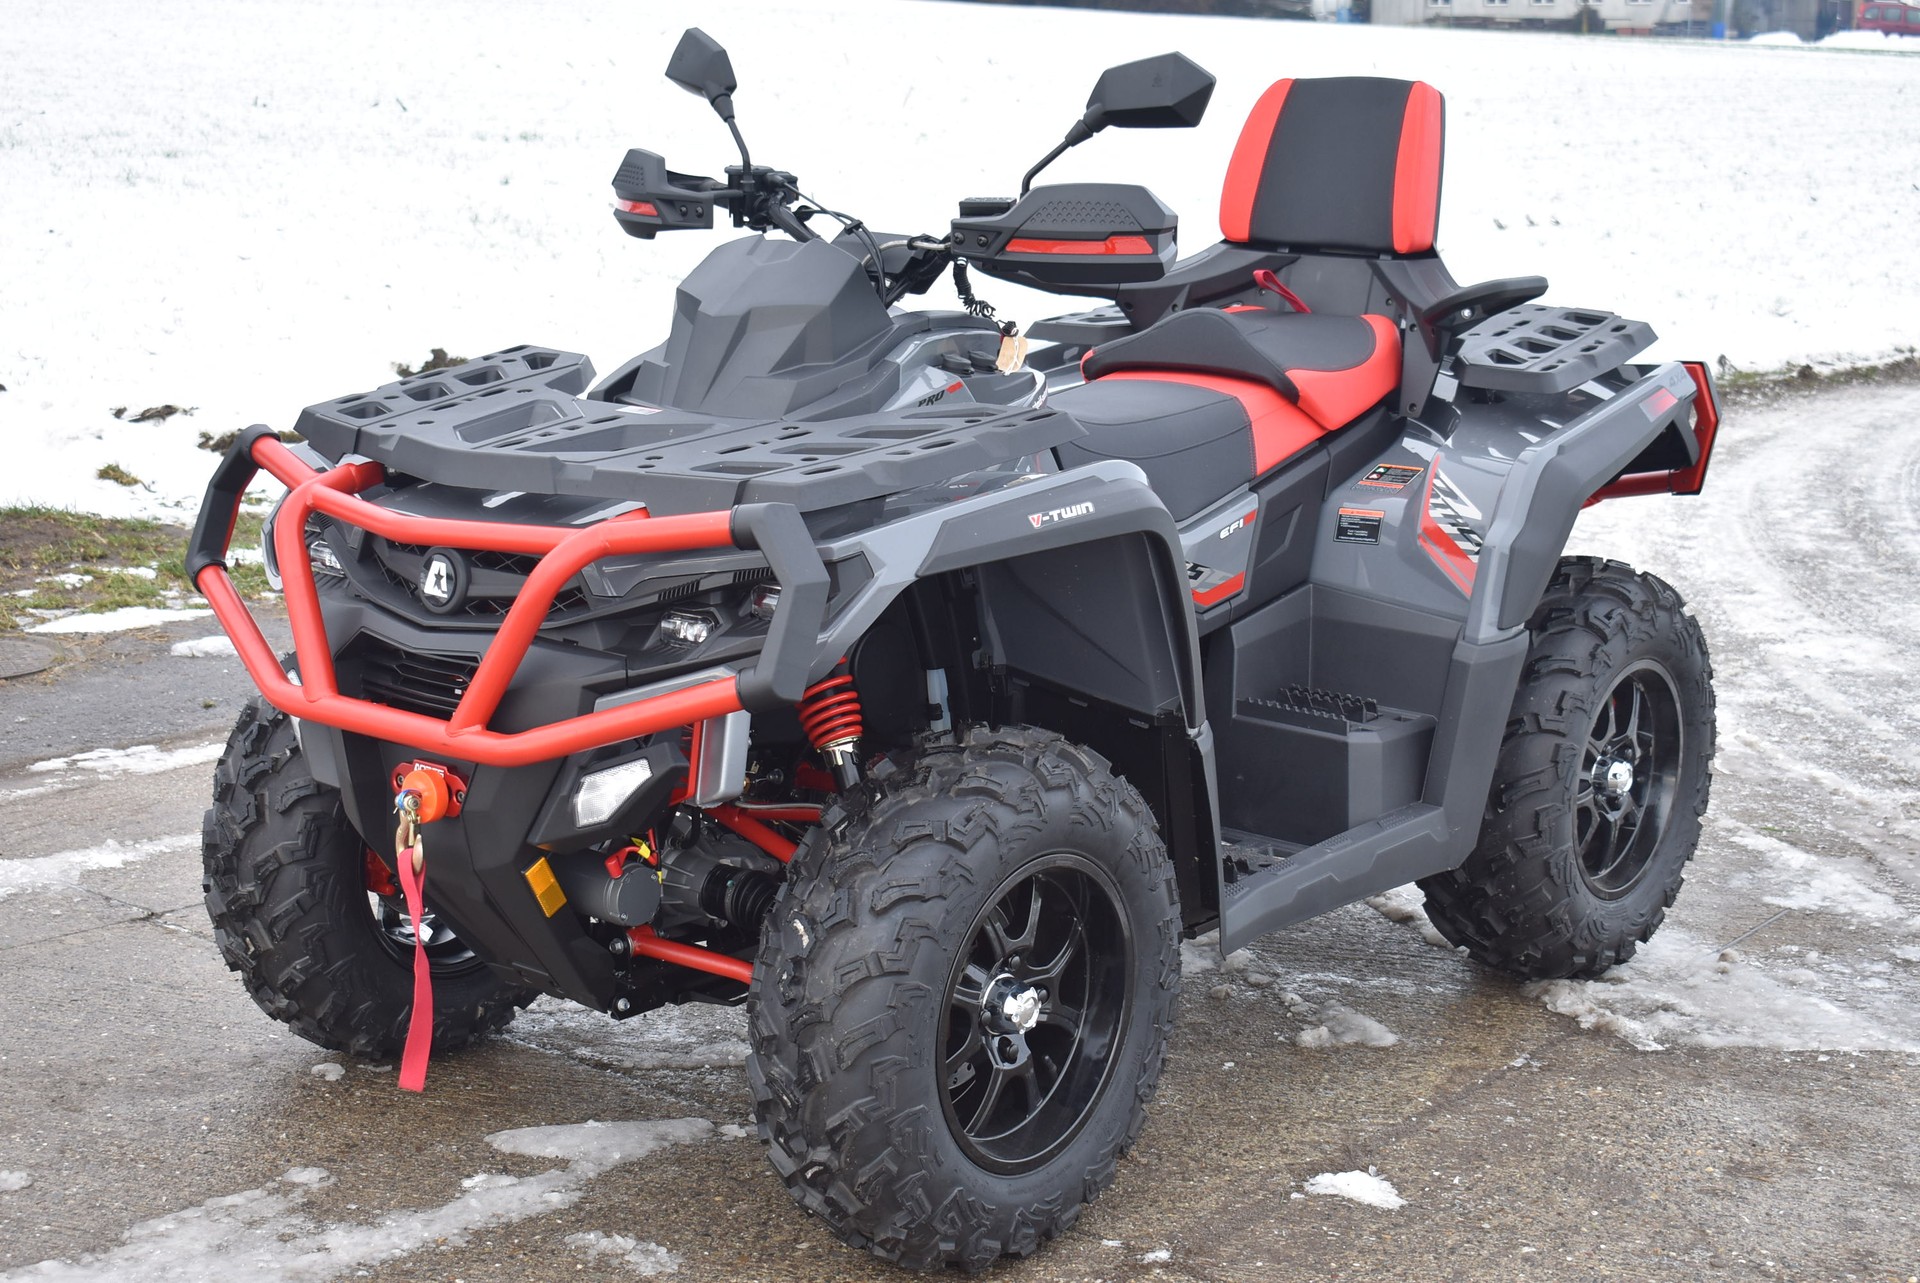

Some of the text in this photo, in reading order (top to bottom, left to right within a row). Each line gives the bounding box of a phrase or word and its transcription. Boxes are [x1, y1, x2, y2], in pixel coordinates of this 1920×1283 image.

[918, 390, 945, 407] PRO
[1029, 501, 1094, 528] V-TWIN
[1219, 518, 1244, 540] EFI
